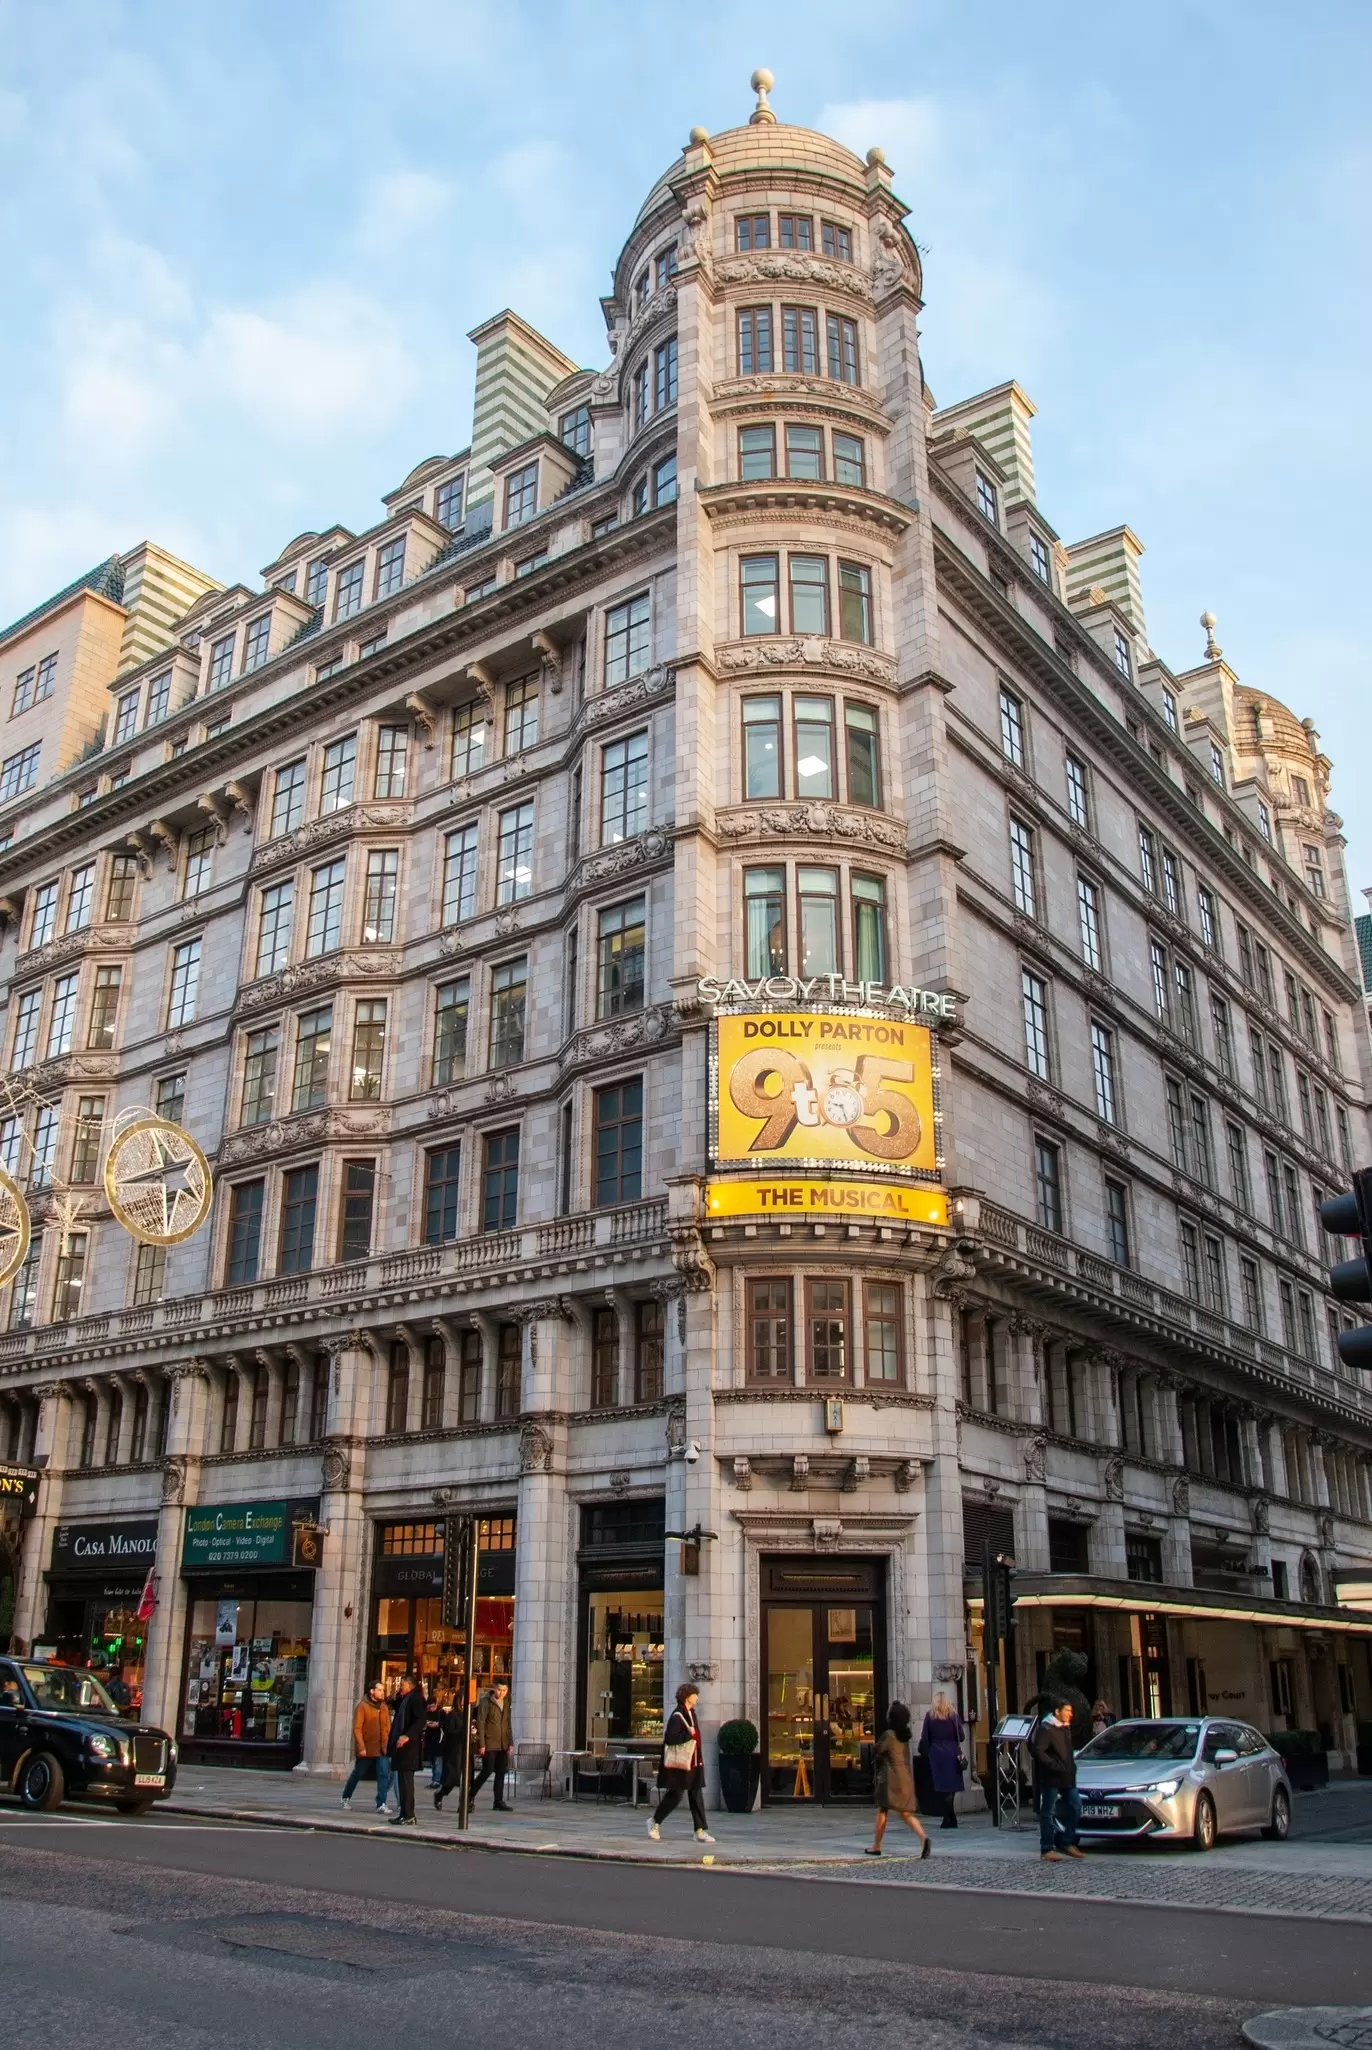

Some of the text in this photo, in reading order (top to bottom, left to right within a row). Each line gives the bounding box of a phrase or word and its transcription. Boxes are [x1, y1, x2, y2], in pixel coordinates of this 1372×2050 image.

[697, 972, 957, 1018] SAVOY THEATRE
[744, 1020, 905, 1046] DOLLY PARTON
[814, 1043, 842, 1052] presents
[757, 1187, 910, 1213] THE MUSICAL
[188, 1511, 282, 1532] London Camera Exchange
[74, 1536, 106, 1556] CASA
[192, 1535, 275, 1548] Photo Optical Video Digital
[208, 1550, 259, 1561] 020 7379 0200
